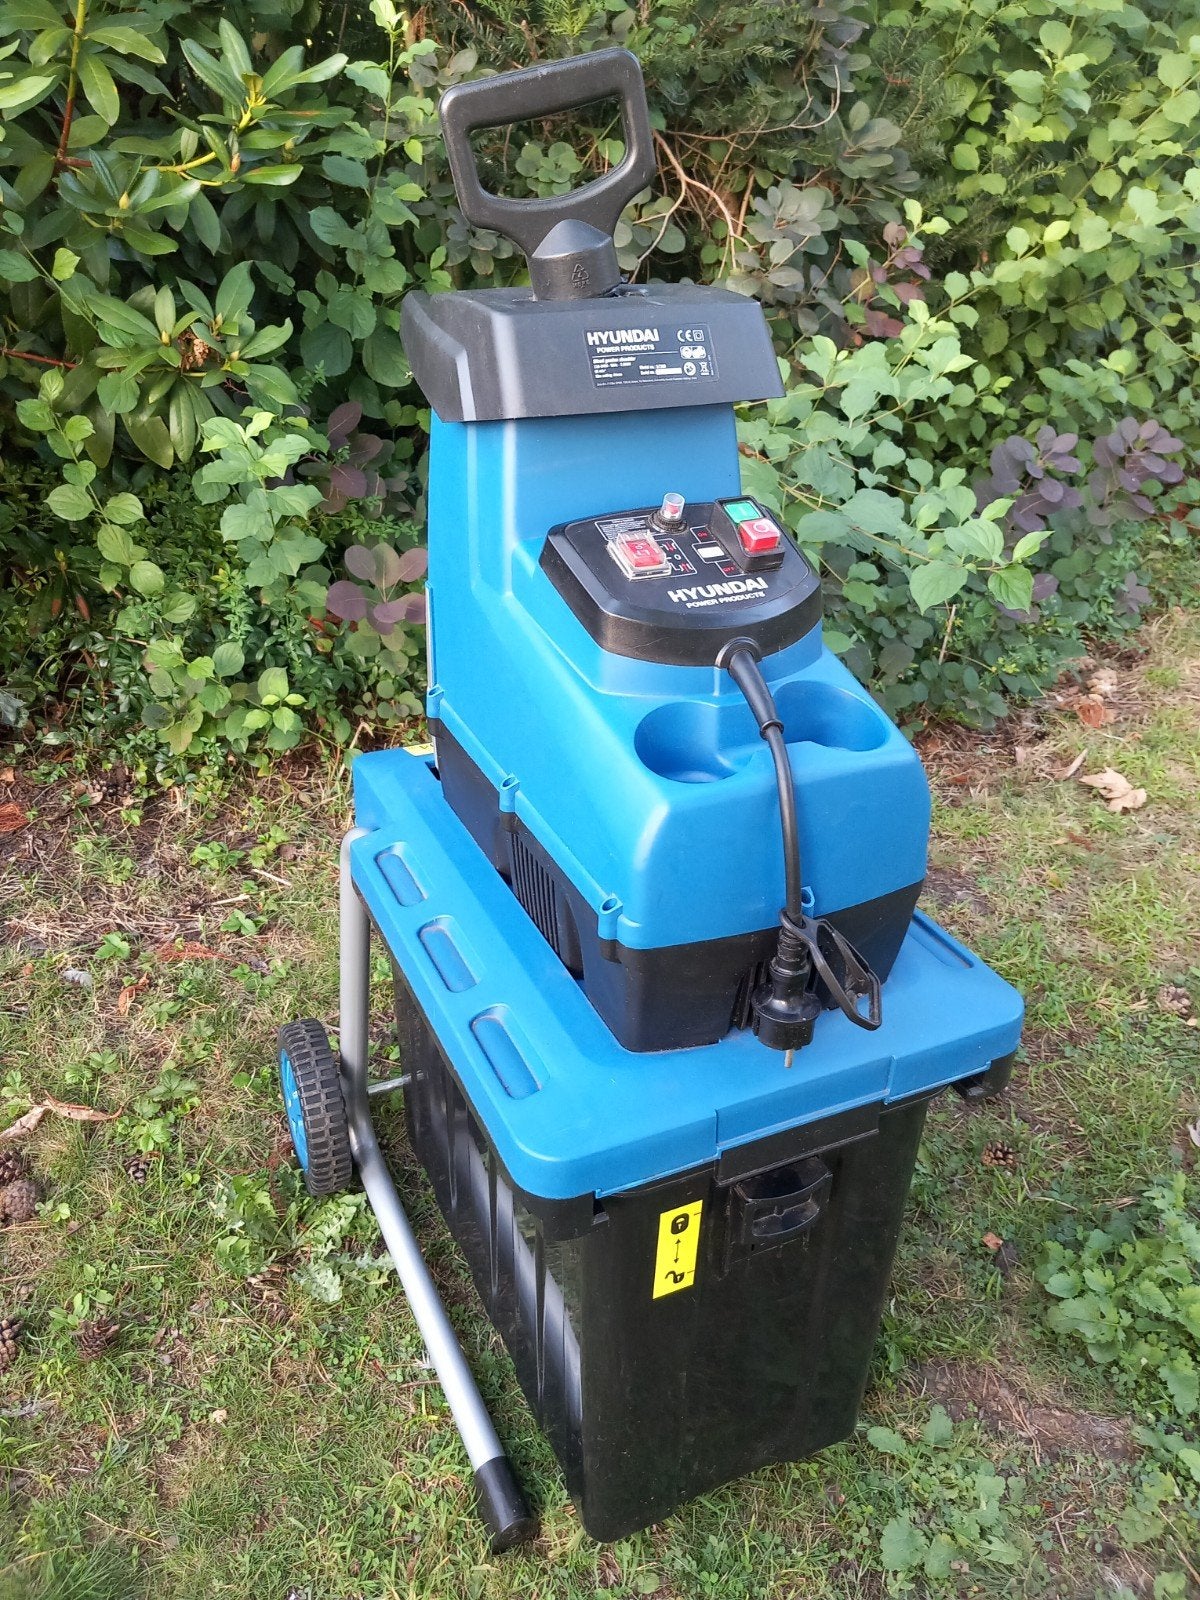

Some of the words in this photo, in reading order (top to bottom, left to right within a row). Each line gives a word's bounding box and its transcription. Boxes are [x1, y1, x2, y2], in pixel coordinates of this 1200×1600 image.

[586, 328, 660, 346] HYUNDAI
[596, 345, 621, 354] POWER
[620, 343, 656, 353] PRODUCTS
[667, 576, 769, 603] HYUNDAI
[685, 598, 719, 609] POWER
[719, 590, 766, 605] PRODUCTS
